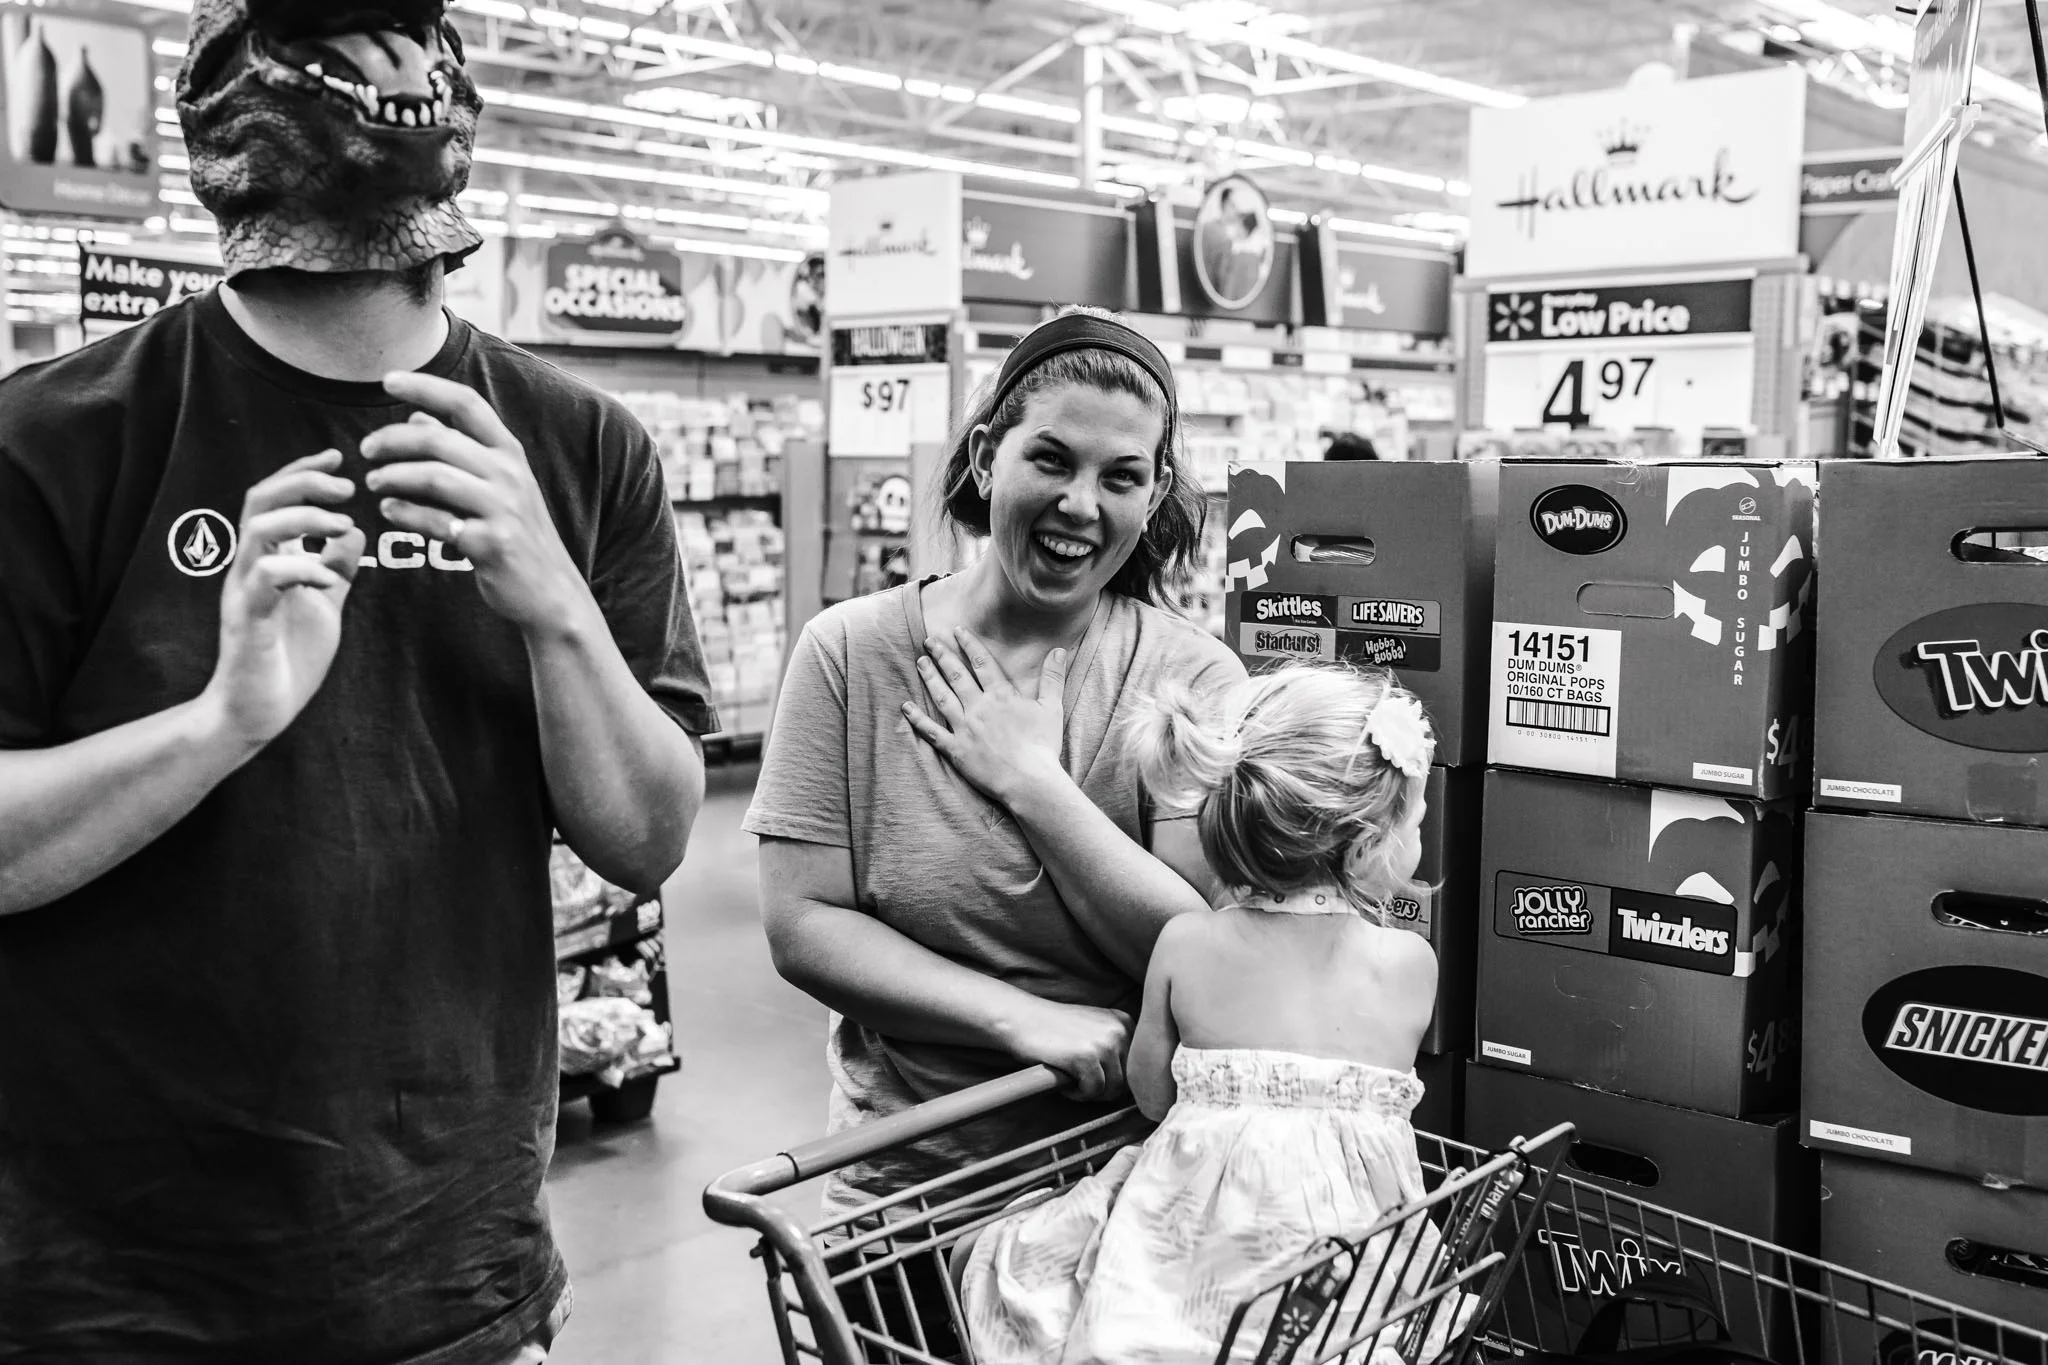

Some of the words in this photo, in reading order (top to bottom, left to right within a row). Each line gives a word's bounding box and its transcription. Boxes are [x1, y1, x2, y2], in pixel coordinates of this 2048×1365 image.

[1496, 145, 1760, 240] Hallmark
[85, 254, 165, 289] Make
[168, 269, 227, 305] you
[83, 289, 161, 317] extra
[1540, 306, 1606, 338] Low
[1608, 297, 1691, 335] Price
[1255, 595, 1323, 622] Skittles
[1256, 630, 1322, 654] Starburst
[1365, 637, 1396, 655] Hubba
[1508, 630, 1590, 662] 14151
[1507, 658, 1535, 671] DUM
[1506, 671, 1567, 687] ORIGINAL
[1570, 676, 1605, 690] POPS
[1506, 683, 1544, 698] 10/160
[1546, 687, 1564, 699] CT
[1566, 690, 1603, 703] BAGS
[1700, 768, 1723, 778] JUMBO
[1723, 772, 1745, 781] SUGAR
[1826, 784, 1851, 793] JUMBO
[1852, 786, 1896, 798] CHOCOLATE
[1514, 891, 1580, 915] JOLLY
[1519, 913, 1588, 930] rancher
[1617, 907, 1729, 955] Twizzlers
[1486, 1046, 1507, 1056] JUMBO
[1507, 1050, 1527, 1060] SUGAR
[1825, 1128, 1851, 1139] JUMBO
[1851, 1131, 1894, 1147] CHOCOLATE
